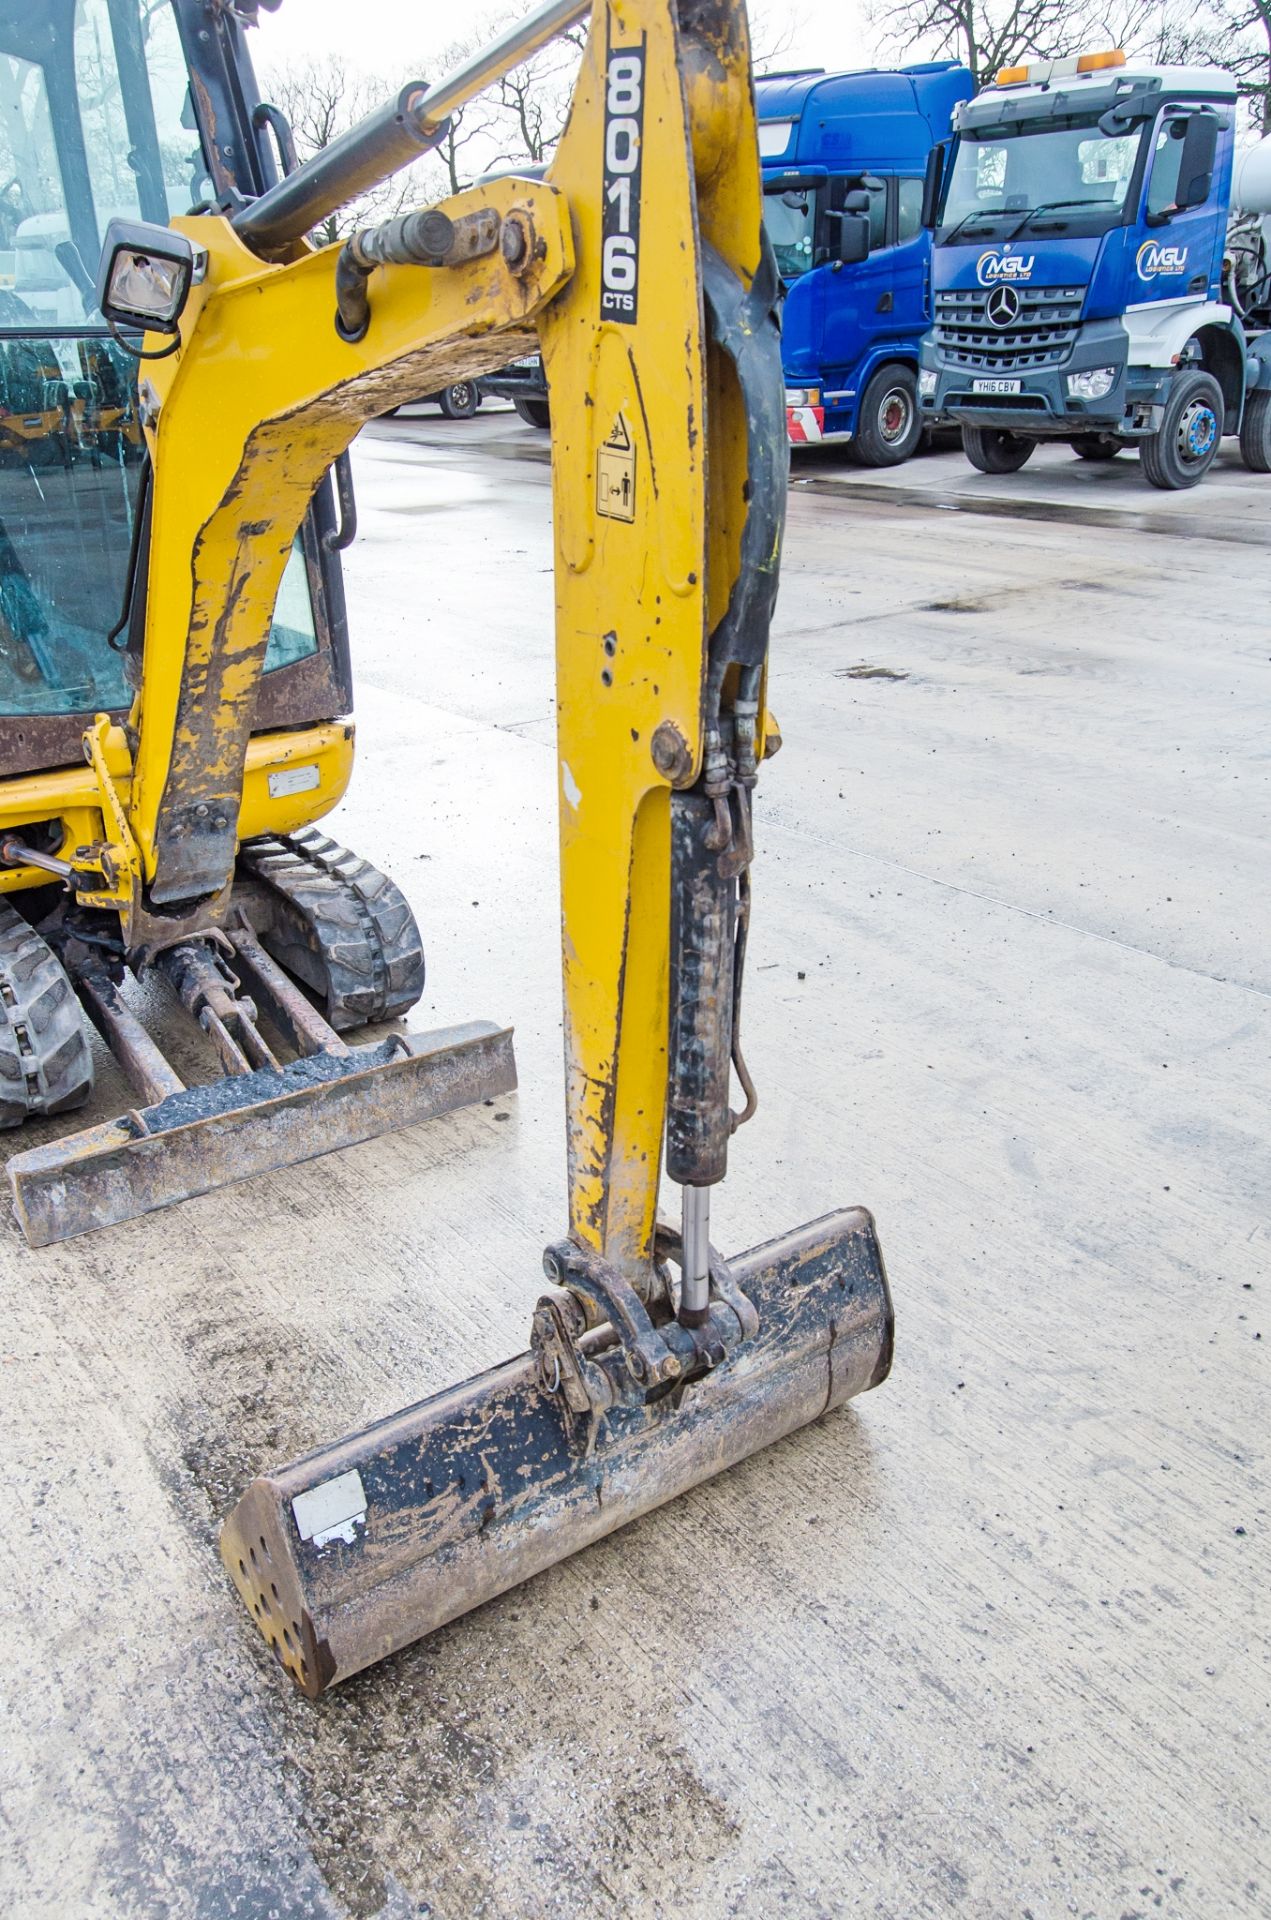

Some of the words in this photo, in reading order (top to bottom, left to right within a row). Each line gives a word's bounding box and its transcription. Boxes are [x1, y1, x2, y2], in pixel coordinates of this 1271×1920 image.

[602, 56, 642, 290] 8016
[986, 255, 1035, 273] MGU
[1146, 247, 1188, 266] MGU
[602, 291, 634, 311] CTS
[978, 382, 996, 392] YH16
[998, 382, 1015, 392] CBV
